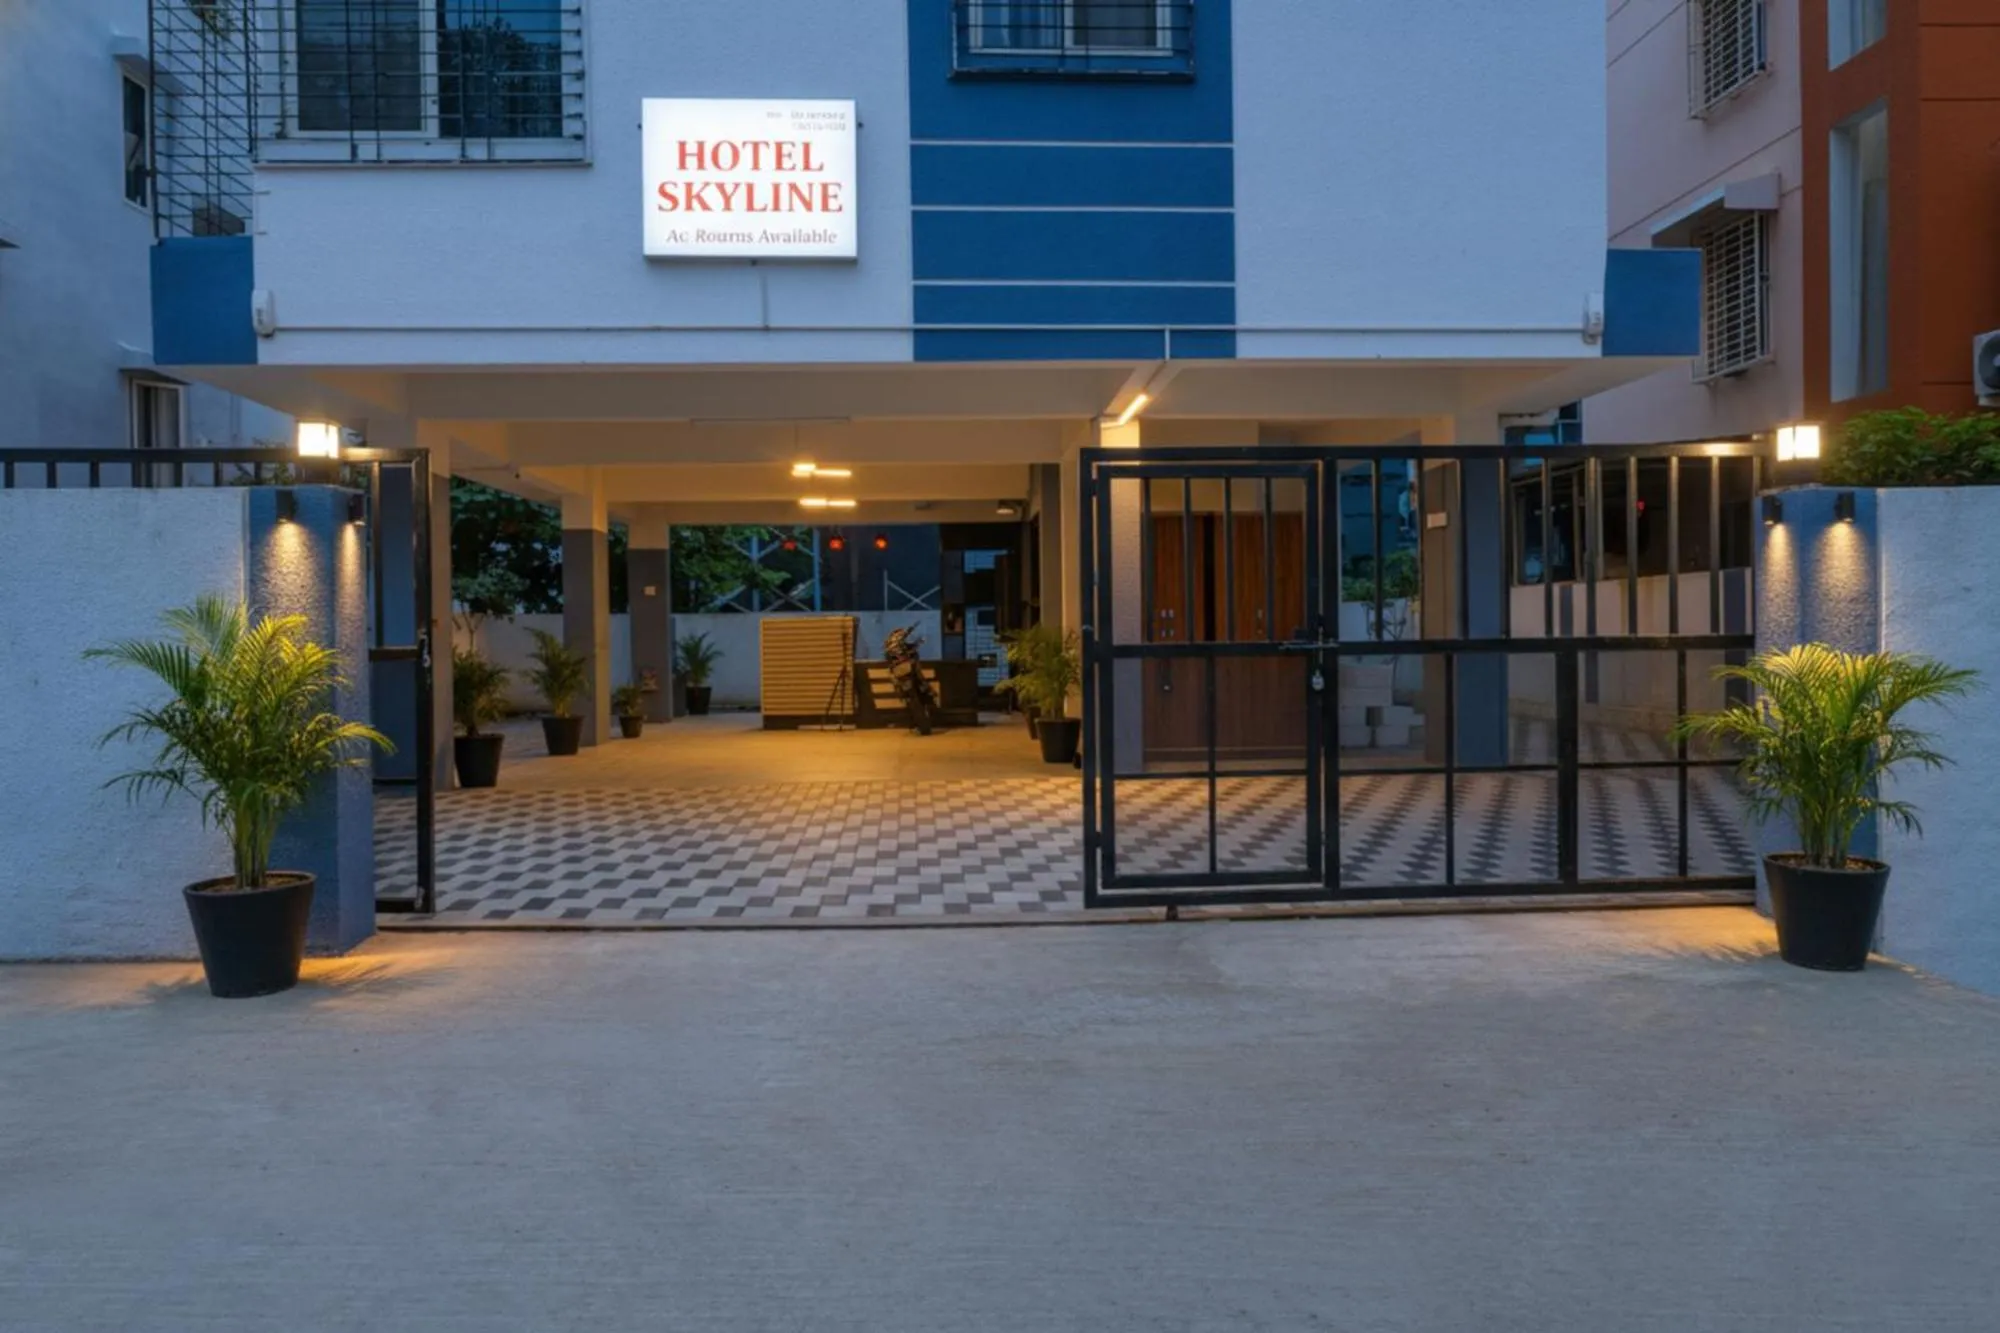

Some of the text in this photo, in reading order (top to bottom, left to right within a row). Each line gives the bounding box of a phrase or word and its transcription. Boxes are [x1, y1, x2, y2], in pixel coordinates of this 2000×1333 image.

[677, 140, 824, 172] HOTEL
[657, 181, 843, 212] SKYLINE
[666, 229, 689, 243] Ac
